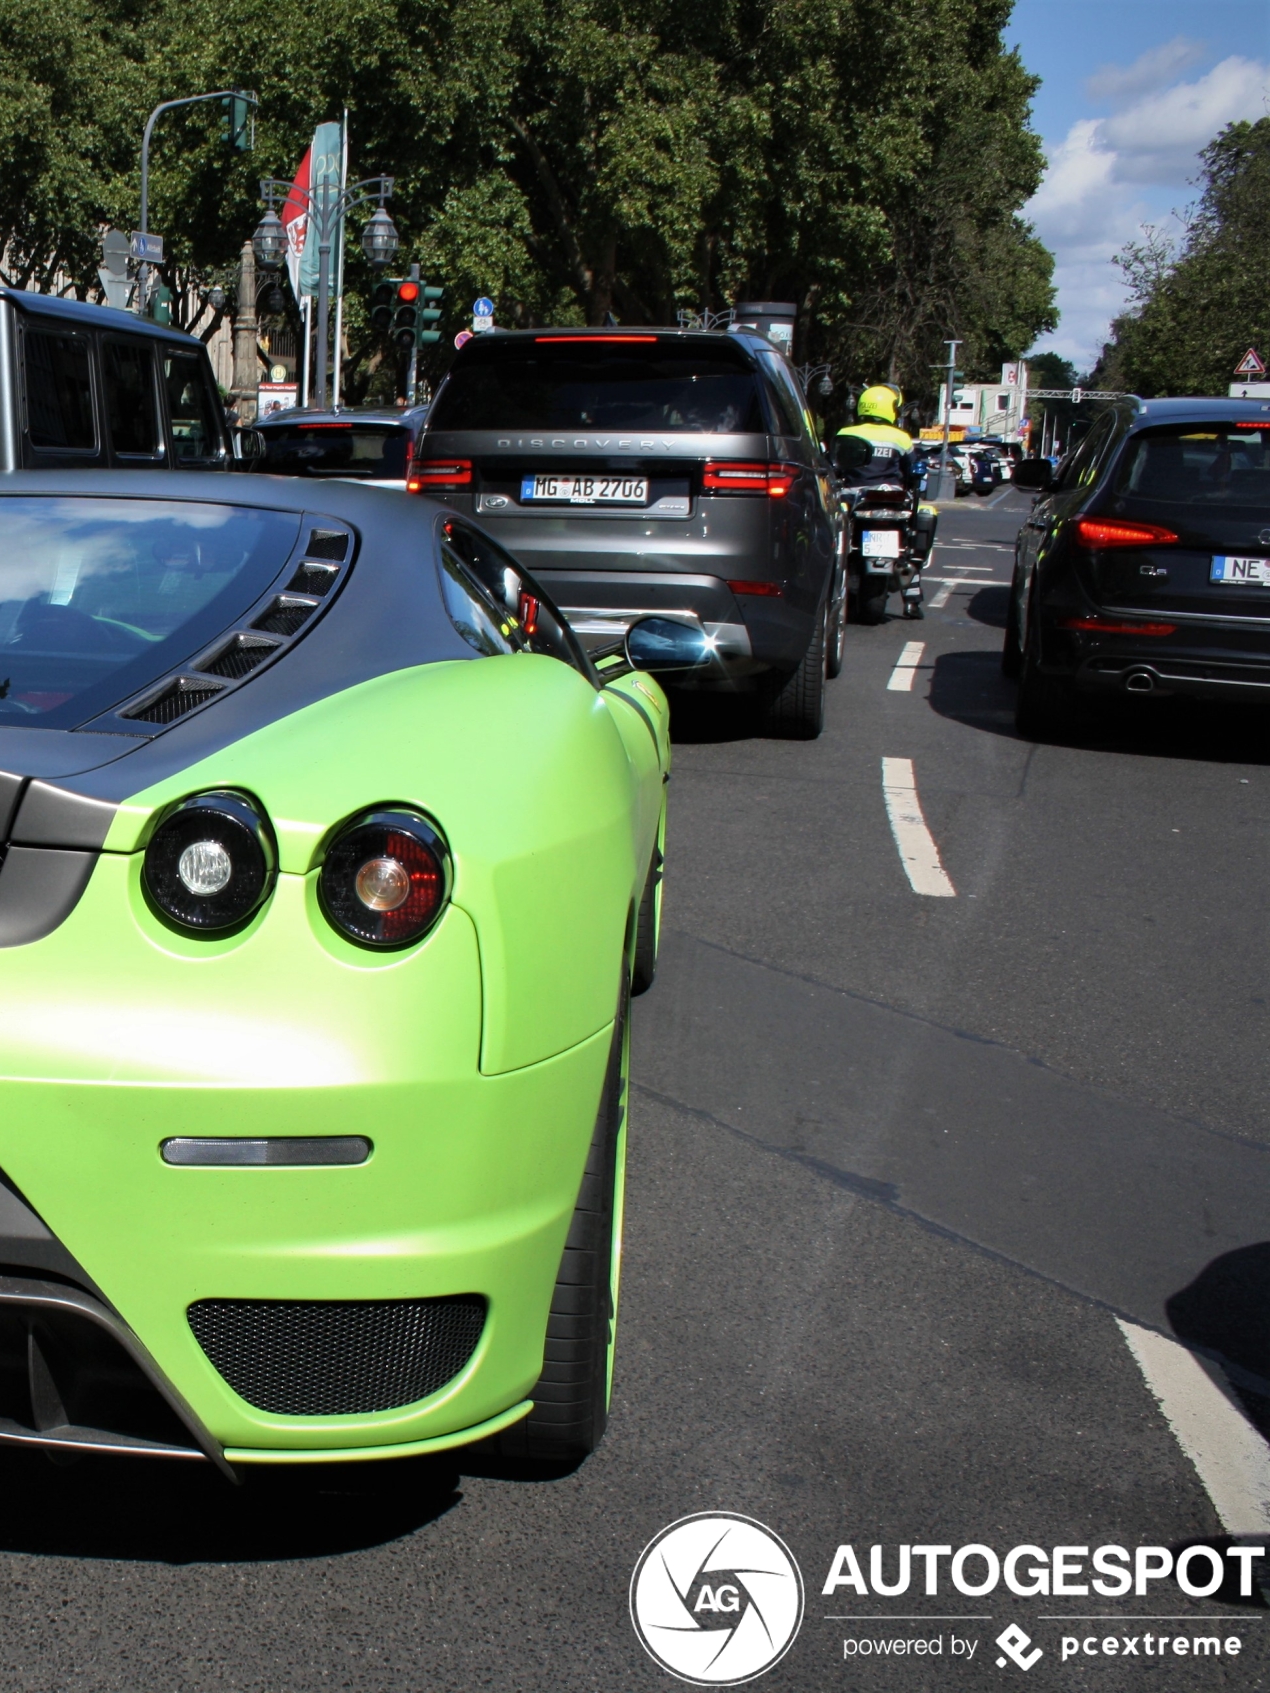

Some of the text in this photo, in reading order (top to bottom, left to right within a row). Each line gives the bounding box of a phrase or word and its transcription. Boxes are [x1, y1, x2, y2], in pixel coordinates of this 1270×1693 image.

[498, 438, 677, 450] DISCOVERY
[535, 477, 558, 496] MG
[571, 478, 595, 497] AB
[599, 478, 644, 498] 2706
[1232, 559, 1261, 579] NE
